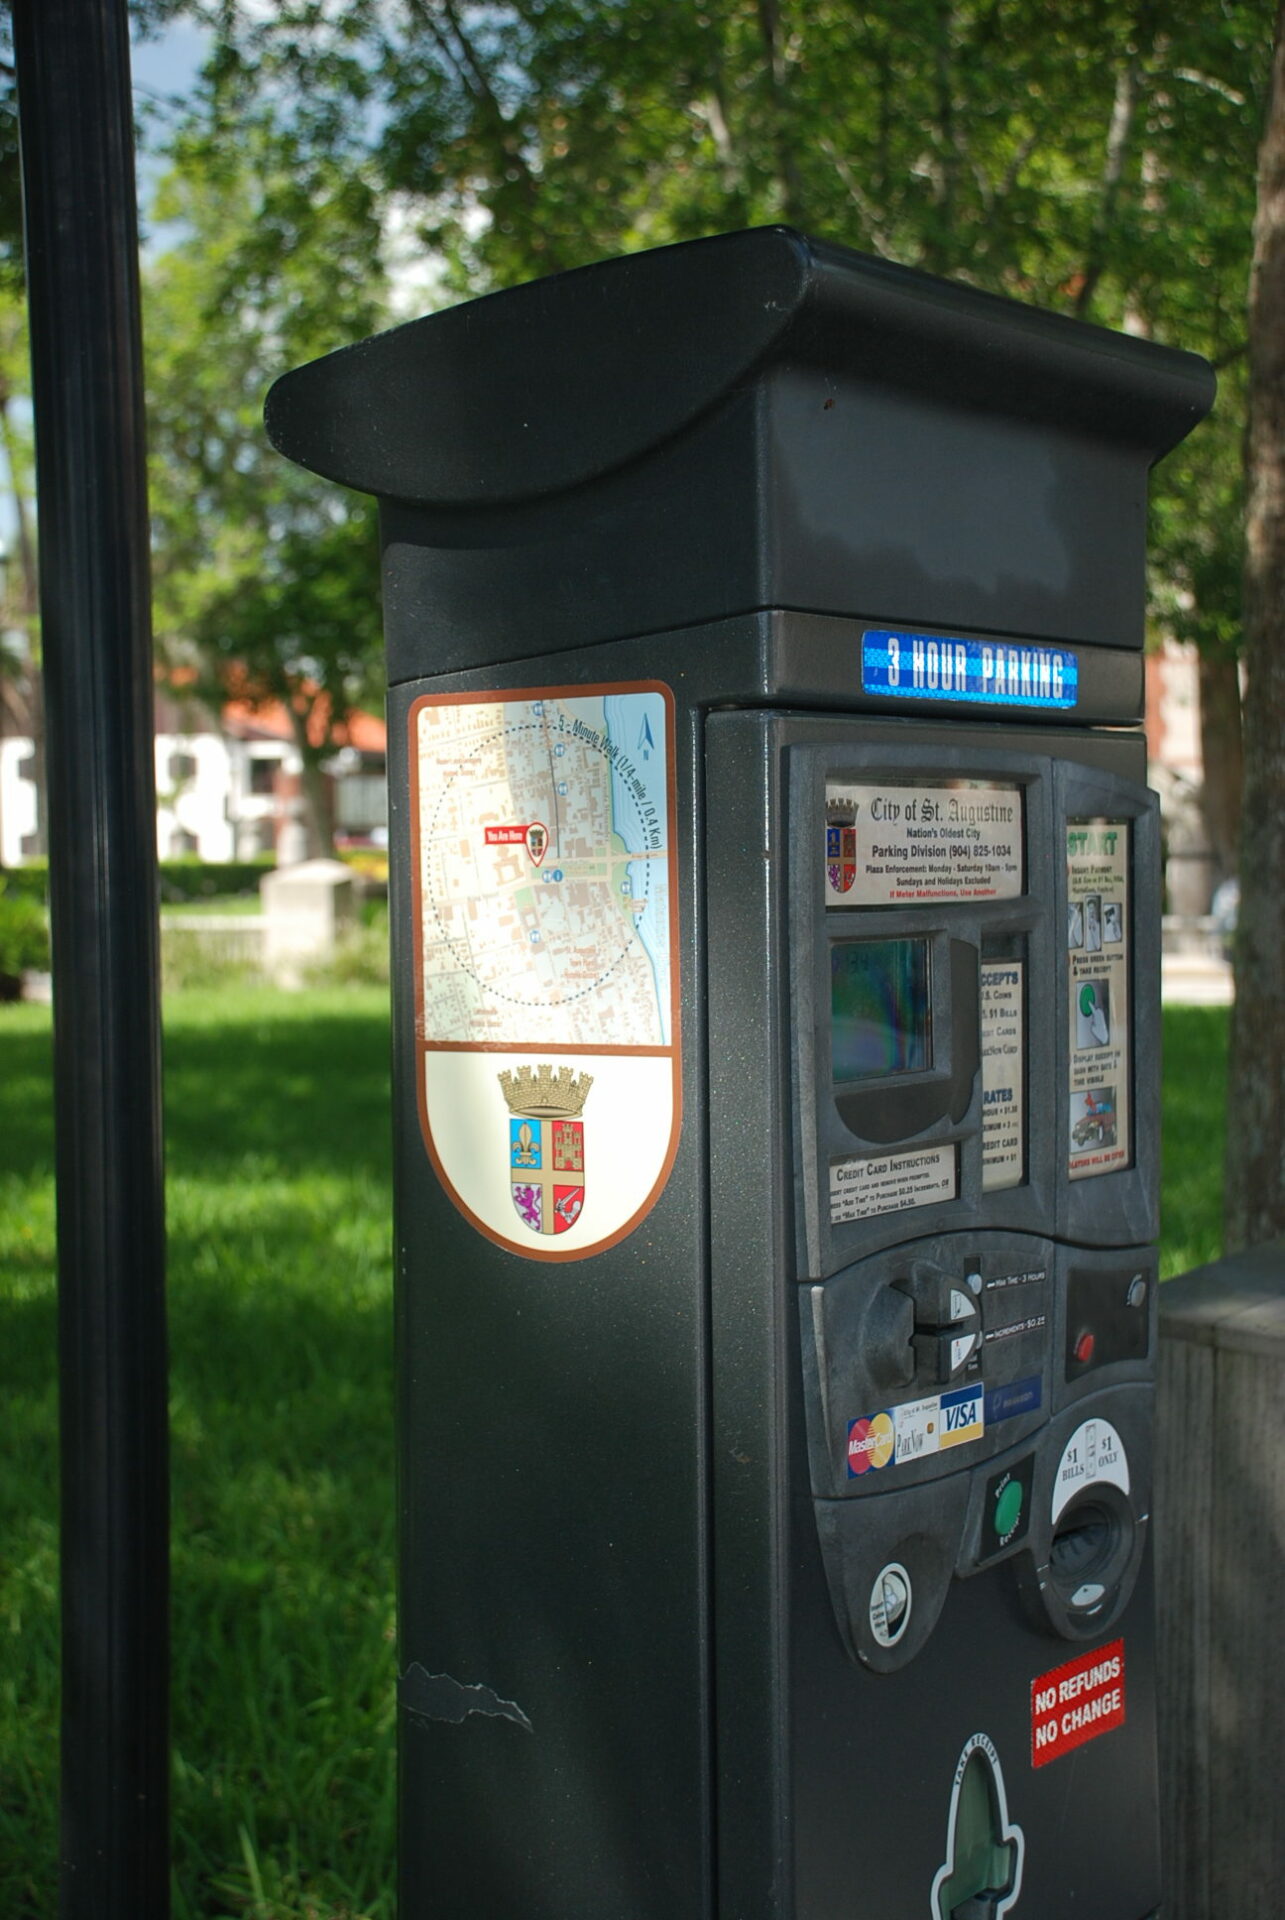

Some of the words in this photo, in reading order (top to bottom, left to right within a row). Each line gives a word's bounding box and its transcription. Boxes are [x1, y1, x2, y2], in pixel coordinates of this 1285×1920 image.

[888, 638, 900, 687] 3
[912, 640, 966, 692] HOUR
[982, 647, 1063, 699] PARKING
[572, 718, 600, 744] Minute
[600, 735, 619, 760] Walk
[871, 797, 900, 826] City
[905, 798, 917, 821] of
[921, 797, 943, 823] St.
[948, 798, 1013, 826] Augustine
[906, 828, 938, 838] Nation's
[940, 828, 964, 838] Oldest
[966, 828, 981, 841] City
[1068, 832, 1118, 856] START
[872, 845, 908, 861] Parking
[911, 845, 946, 857] Division
[949, 845, 971, 859] (904)
[973, 845, 1011, 857] 825-1034
[865, 865, 884, 873] Plaza
[885, 864, 927, 874] Enforcement:
[928, 864, 952, 875] Monday
[957, 864, 983, 874] Saturday
[896, 877, 923, 888] Sundays
[924, 877, 936, 886] and
[937, 877, 963, 887] Holidays
[965, 876, 991, 885] Excluded
[896, 890, 915, 898] Meter
[980, 971, 1018, 986] CCEPTS
[983, 1088, 1012, 1104] RATES
[982, 1140, 1000, 1150] REDIT
[837, 1168, 864, 1181] CREDIT
[867, 1163, 887, 1176] CARD
[890, 1154, 940, 1171] INSTRUCTIONS
[946, 1401, 977, 1431] VISA
[848, 1432, 893, 1456] MasterCard
[1101, 1436, 1112, 1452] $1
[1066, 1447, 1077, 1463] $1
[1098, 1451, 1119, 1468] ONLY
[1062, 1464, 1085, 1481] BILLS
[1035, 1687, 1056, 1715] NO
[1059, 1656, 1120, 1703] REFUNDS
[1036, 1720, 1058, 1749] NO
[1061, 1688, 1121, 1735] CHANGE
[970, 1735, 998, 1764] RECEIPT
